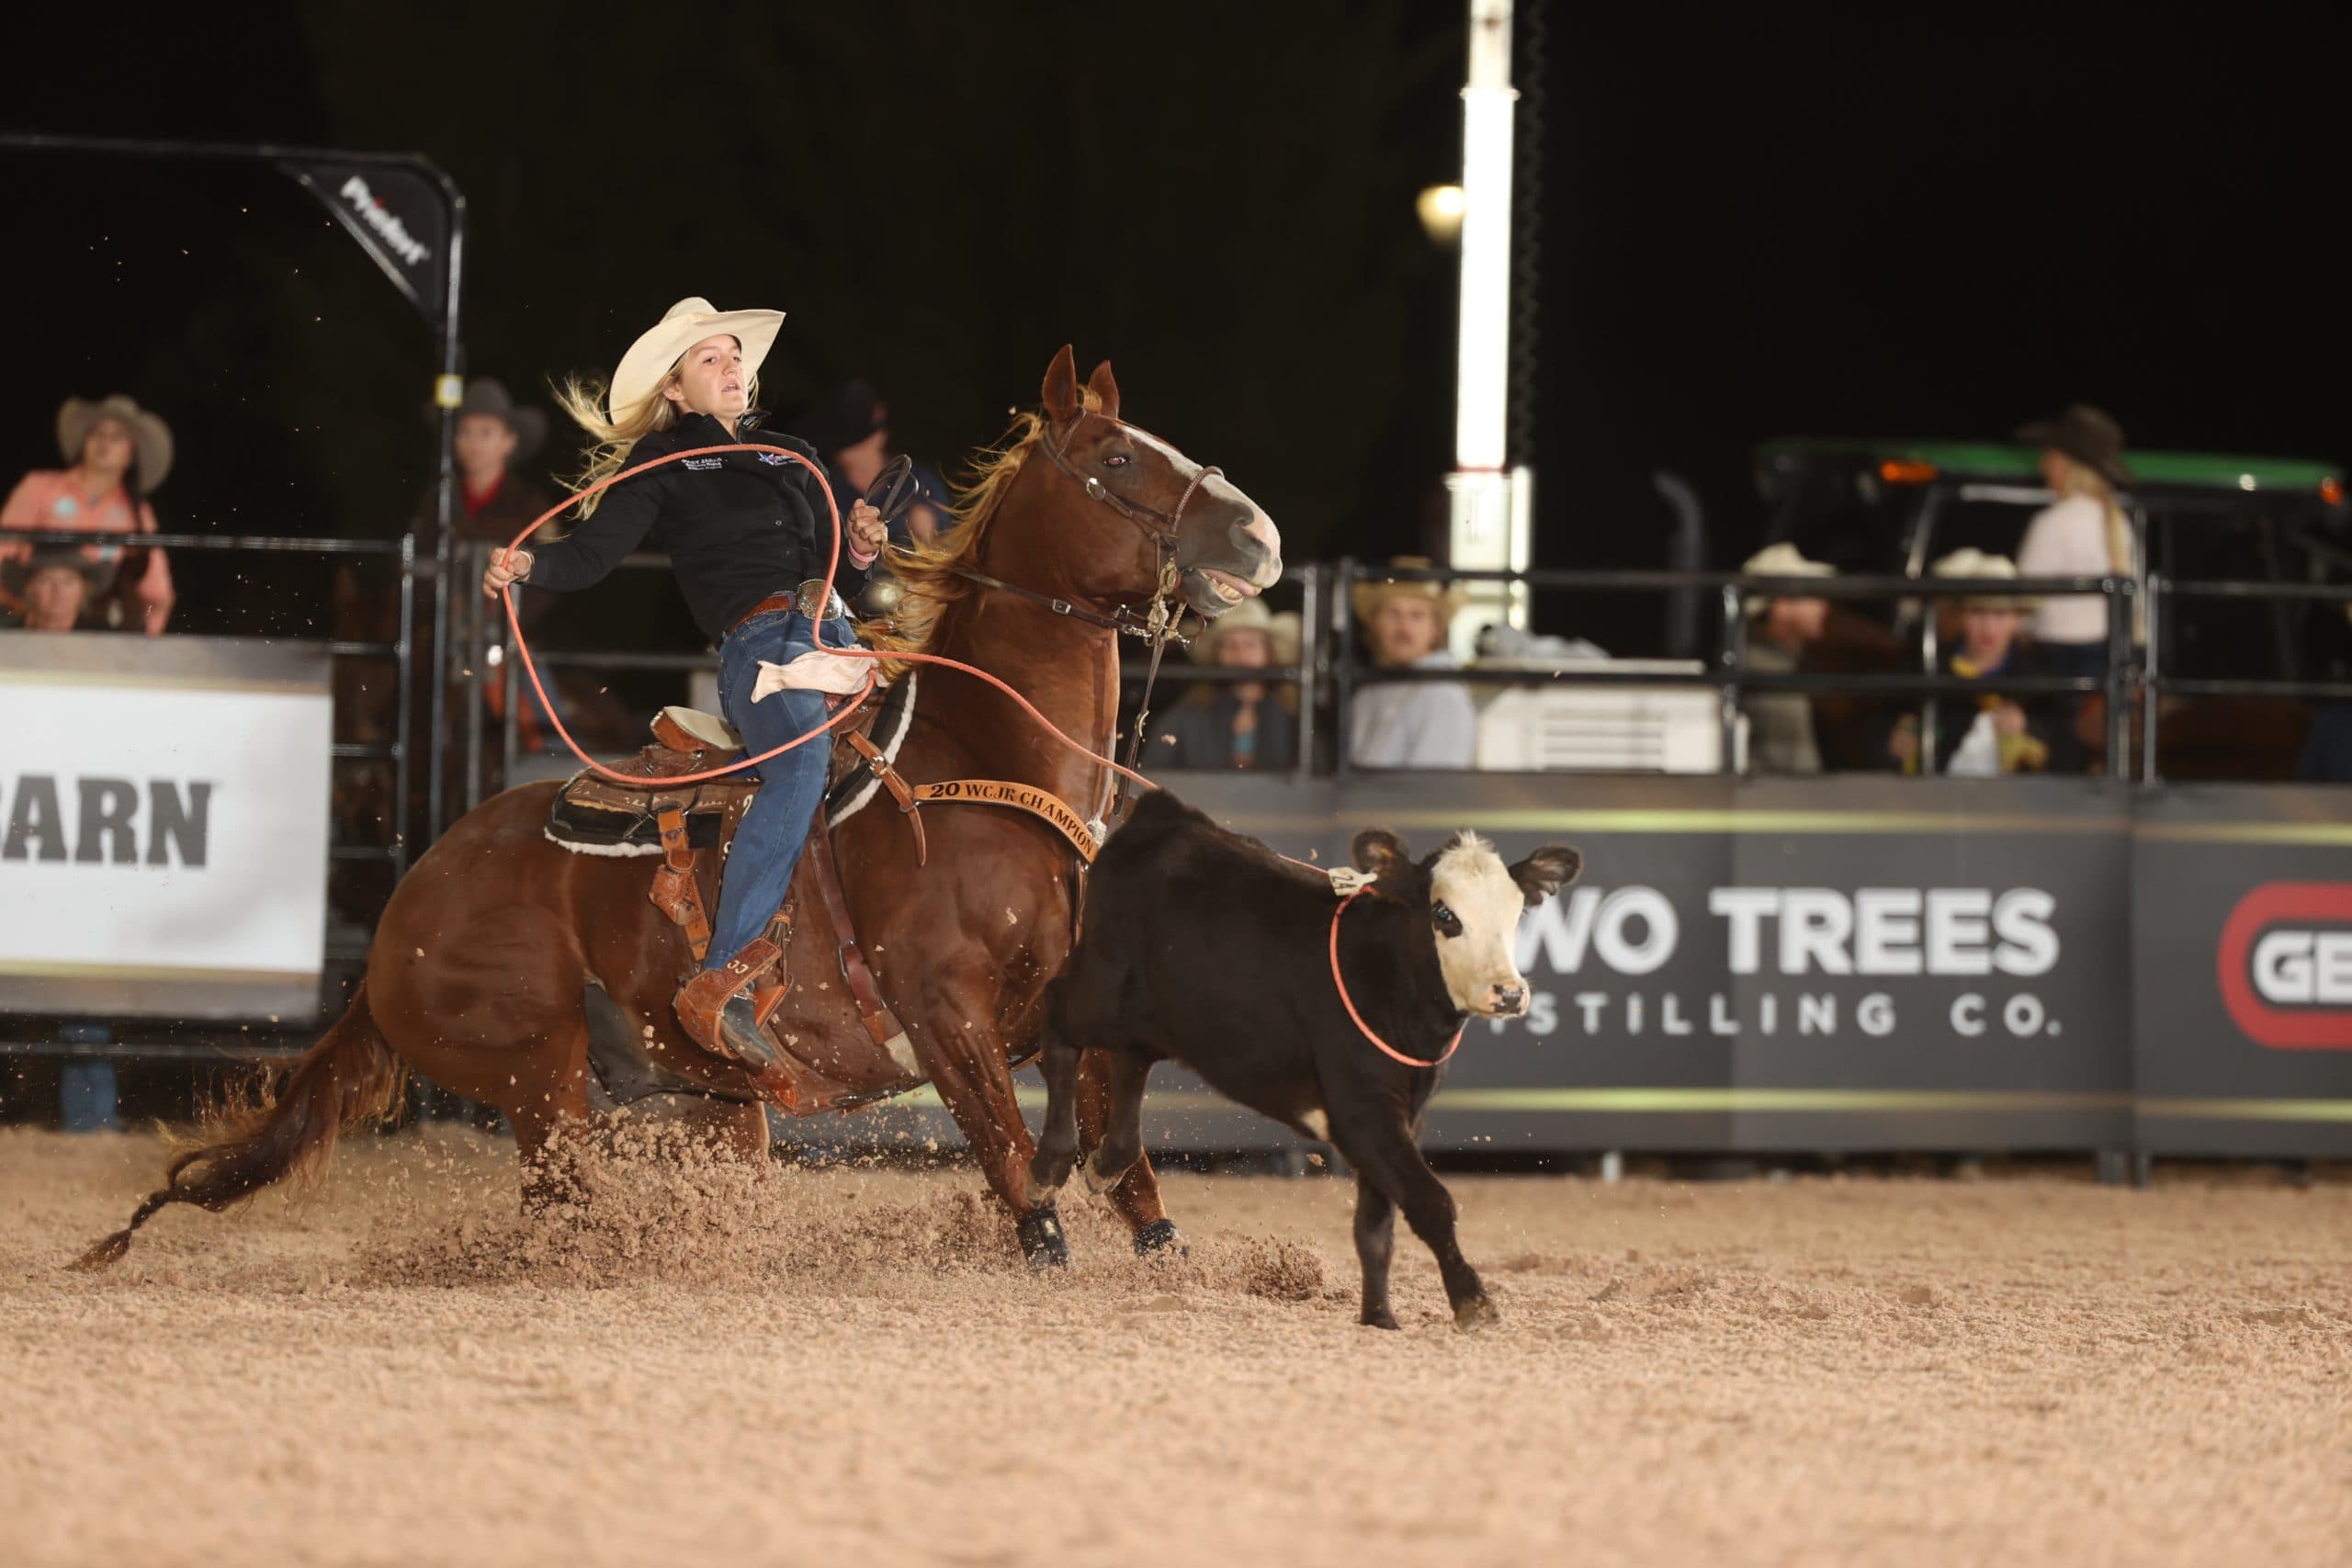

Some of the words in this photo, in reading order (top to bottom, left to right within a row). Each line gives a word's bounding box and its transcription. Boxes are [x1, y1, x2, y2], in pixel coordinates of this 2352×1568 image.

[0, 774, 212, 867] ARN
[929, 783, 960, 798] 20
[1020, 792, 1093, 855] CHAMPION
[1516, 886, 1679, 975] WO
[1709, 886, 2060, 975] TREES
[1489, 991, 1894, 1035] STILLING
[1950, 992, 2062, 1035] CO.
